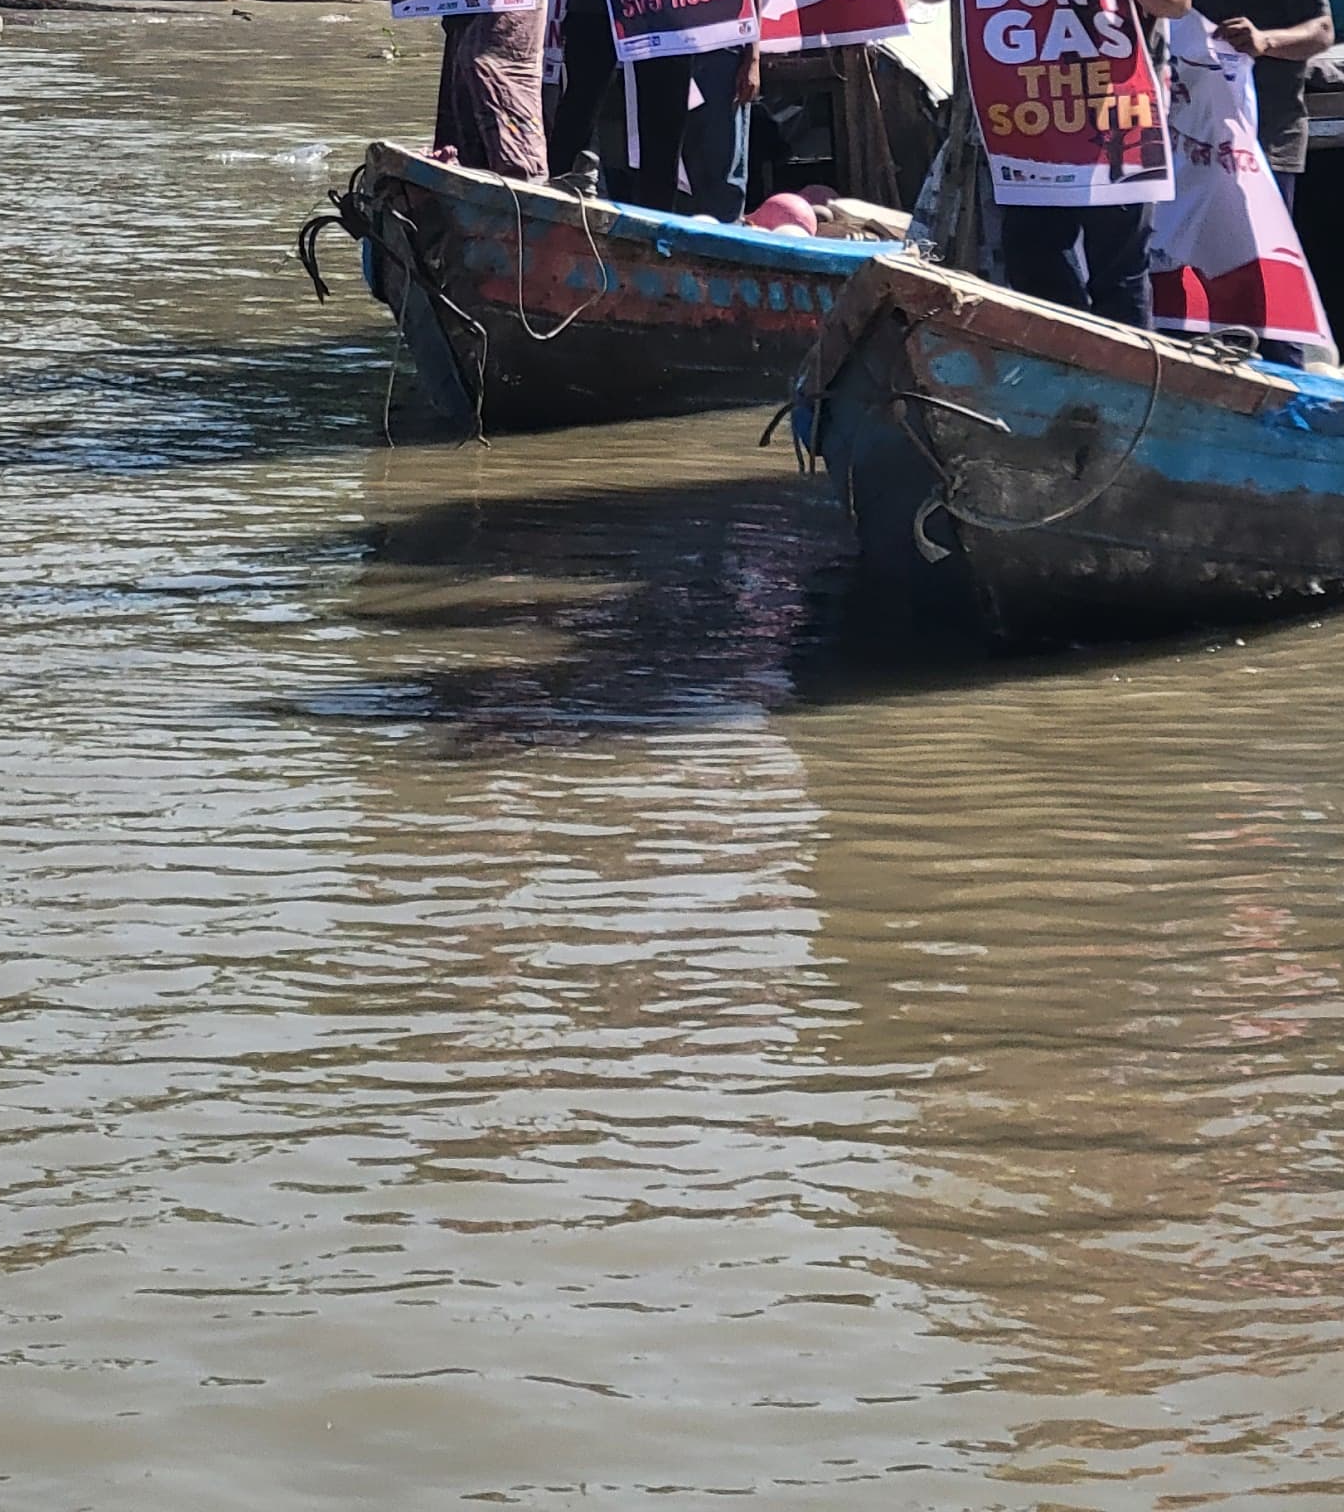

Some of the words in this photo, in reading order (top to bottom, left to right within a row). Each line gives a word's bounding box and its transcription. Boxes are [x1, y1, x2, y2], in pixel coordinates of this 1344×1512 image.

[982, 8, 1133, 65] GAS
[1017, 61, 1114, 99] THE
[988, 93, 1153, 136] SOUTH
